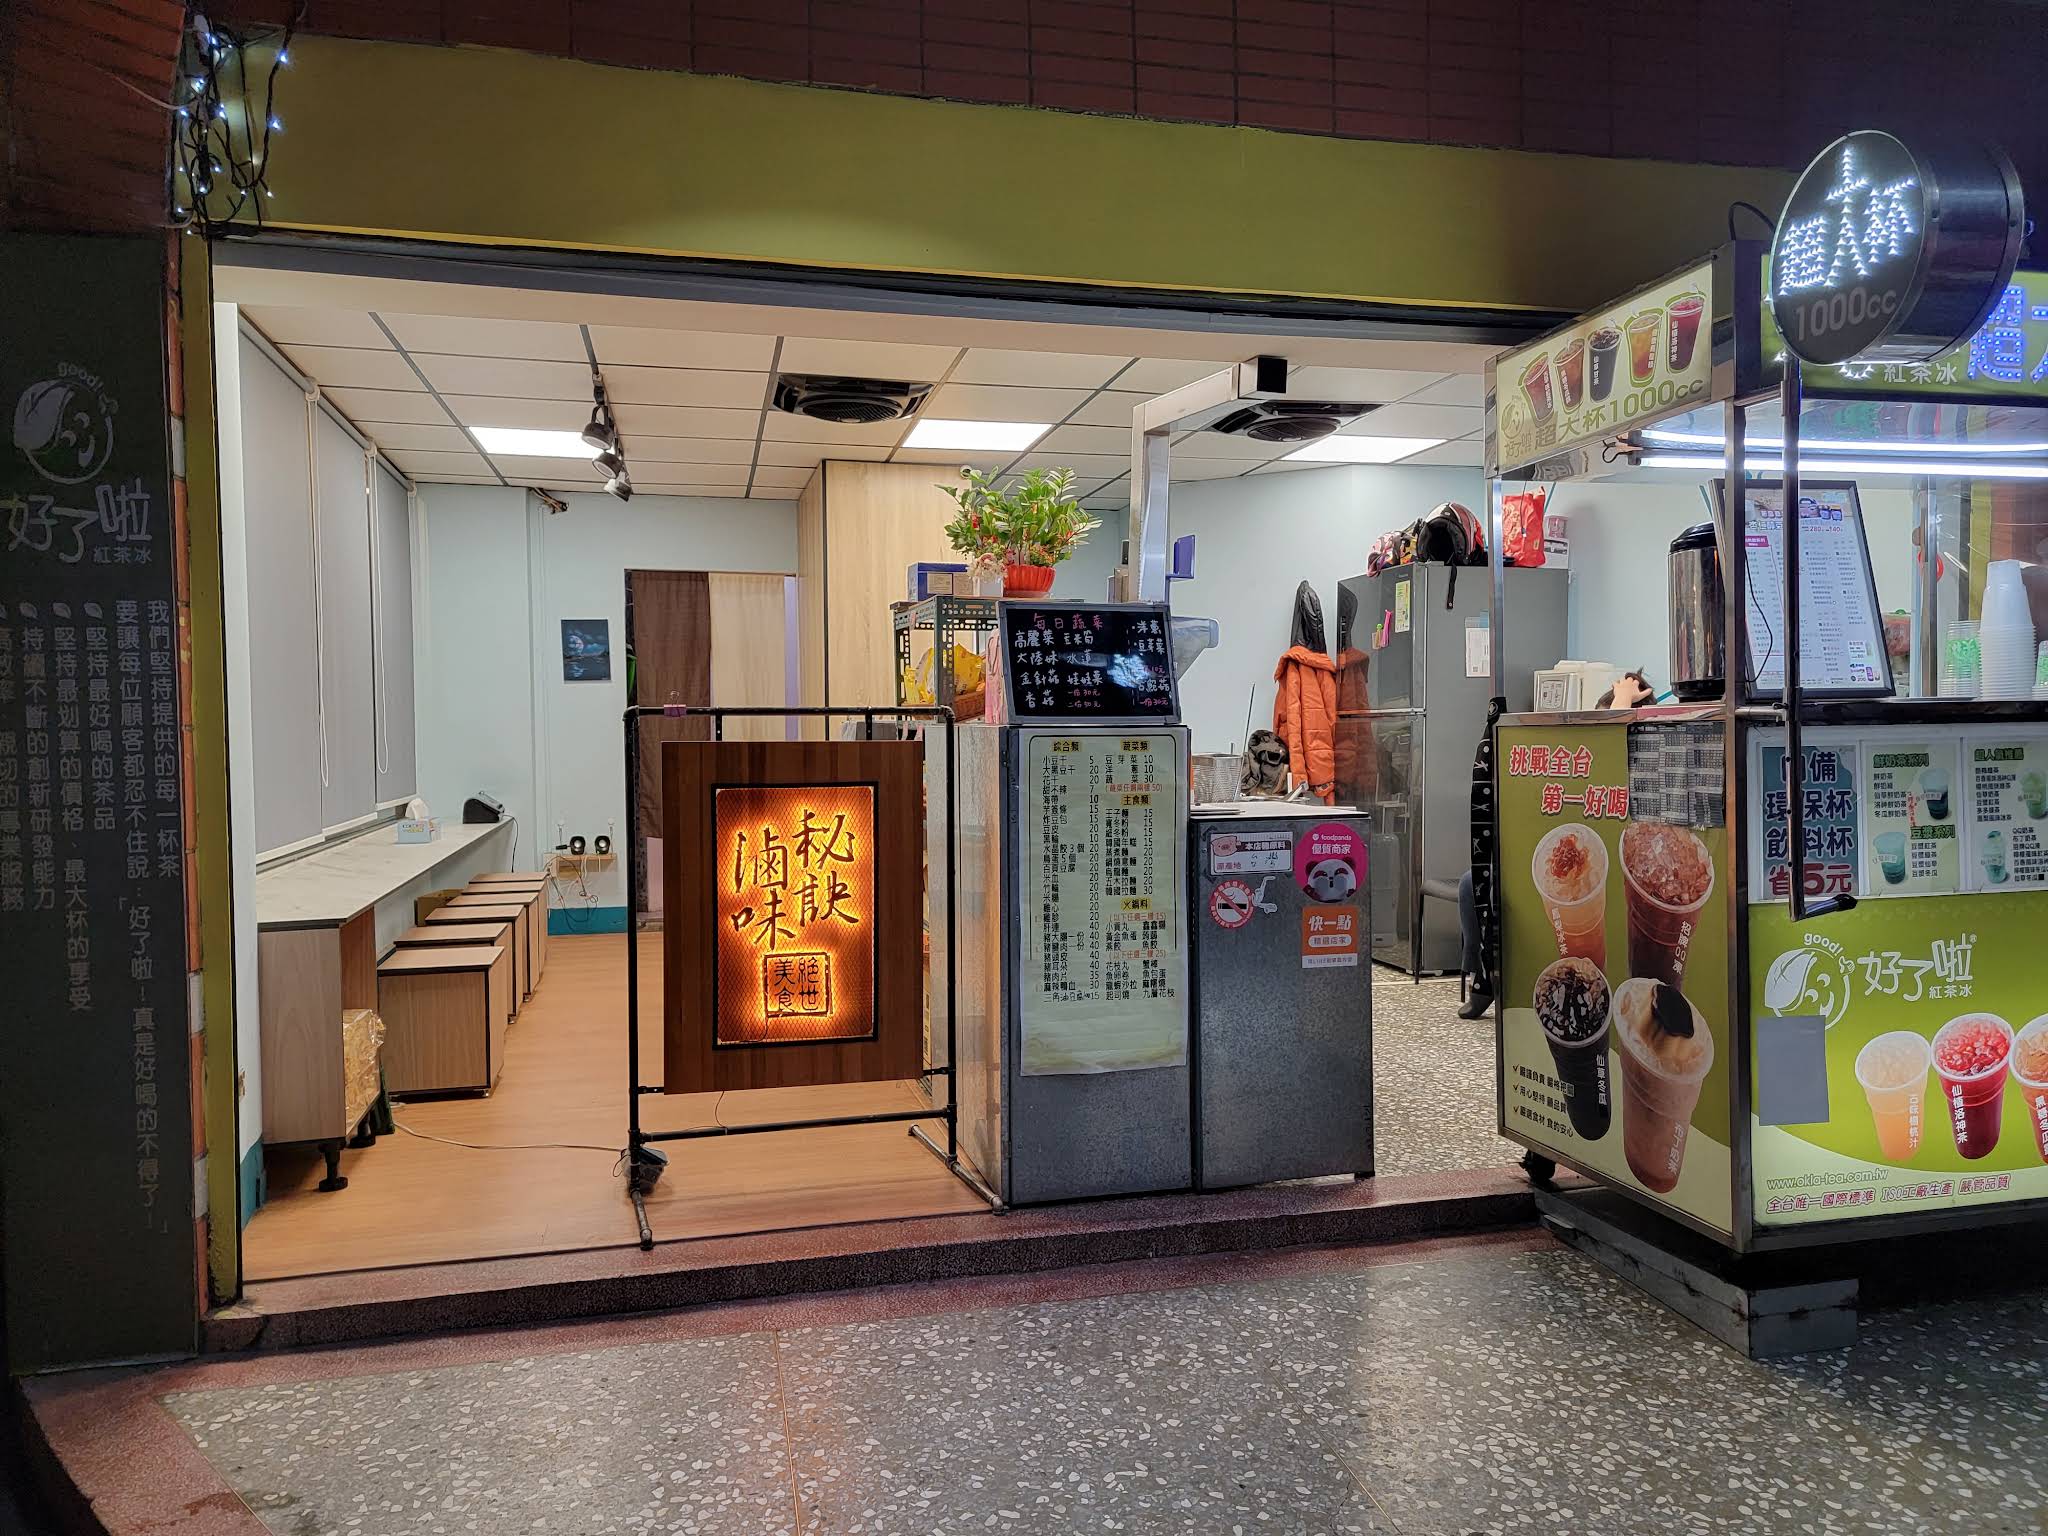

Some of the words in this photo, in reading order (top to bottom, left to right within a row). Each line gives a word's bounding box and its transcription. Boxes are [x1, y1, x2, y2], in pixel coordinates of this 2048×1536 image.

[1793, 286, 1897, 342] 1000cc
[1883, 361, 1958, 386] 紅茶冰
[93, 546, 153, 565] 紅茶冰
[1033, 612, 1104, 630] 每日蔬菜
[1014, 629, 1055, 648] 高麗菜
[1138, 638, 1166, 655] 豆芽菜
[1016, 650, 1059, 666] 大陸妹
[1020, 668, 1060, 686] 金針菇
[1025, 689, 1056, 709] 香菇
[85, 627, 116, 831] 堅持最好喝的茶品
[147, 600, 180, 878] 我們堅持提供的每一杯茶
[1089, 755, 1094, 765] 5
[1143, 754, 1154, 764] 10
[1509, 744, 1594, 778] 挑戰全台
[1873, 753, 1930, 768] 鮮奶茶系列
[1089, 765, 1100, 775] 20
[1144, 764, 1154, 774] 10
[1089, 775, 1100, 785] 20
[1144, 774, 1154, 784] 30
[1089, 785, 1095, 794] 7
[1089, 794, 1100, 804] 10
[1089, 804, 1099, 814] 15
[1143, 808, 1154, 818] 15
[1089, 814, 1099, 824] 15
[1143, 818, 1154, 827] 15
[1089, 824, 1100, 833] 20
[1143, 827, 1154, 837] 15
[1910, 824, 1956, 840] 豆漿系列
[1089, 833, 1100, 843] 10
[1143, 837, 1154, 847] 15
[1089, 843, 1100, 853] 20
[1143, 847, 1154, 857] 20
[1089, 853, 1100, 863] 20
[1143, 857, 1154, 866] 20
[791, 809, 860, 928] 秘訣
[1089, 862, 1100, 872] 20
[1143, 866, 1154, 876] 20
[1089, 872, 1100, 882] 20
[1143, 876, 1154, 885] 20
[731, 827, 797, 951] 滷味
[1089, 882, 1100, 892] 20
[1143, 886, 1154, 895] 30
[1089, 892, 1100, 902] 20
[1089, 901, 1100, 911] 20
[1089, 911, 1100, 921] 20
[1089, 921, 1100, 931] 40
[1308, 915, 1352, 932] 快一點
[1089, 930, 1100, 941] 40
[1089, 940, 1100, 950] 40
[1804, 932, 1844, 957] good!
[1089, 950, 1100, 960] 40
[1089, 960, 1100, 970] 40
[1857, 932, 1973, 1002] 好了啦
[1089, 970, 1100, 980] 35
[774, 958, 797, 1014] 美食
[1089, 980, 1100, 990] 30
[1090, 991, 1101, 1001] 15
[1928, 984, 1972, 999] 紅茶冰
[1766, 1189, 1876, 1213] 全台唯一國際標準
